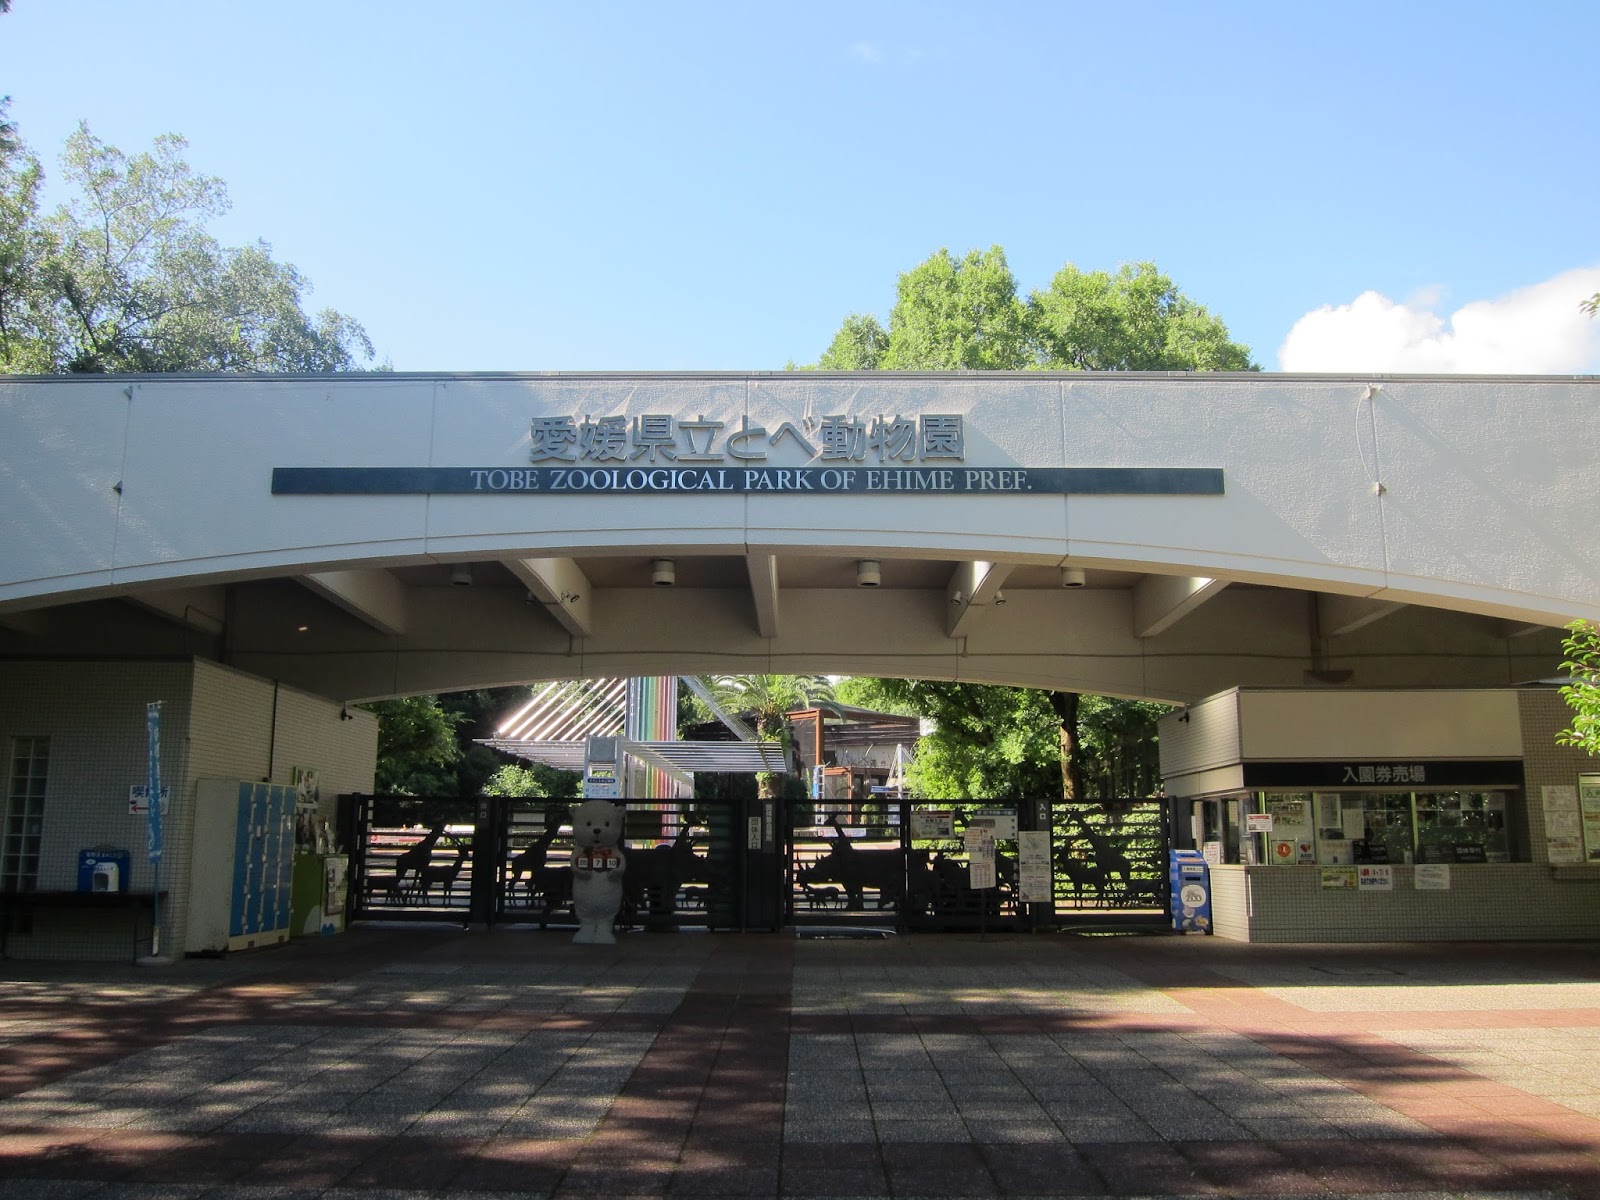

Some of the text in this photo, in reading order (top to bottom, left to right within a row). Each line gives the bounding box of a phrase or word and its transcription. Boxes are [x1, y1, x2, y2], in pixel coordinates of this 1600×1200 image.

[530, 414, 966, 462] 愛媛県立とべ動物園
[470, 469, 1033, 491] TOBE ZOOLOGICAL PARK OF EHIME PREF.
[1342, 765, 1425, 783] 入園券売場
[1039, 803, 1047, 820] 入口
[751, 817, 759, 849] 団体入口
